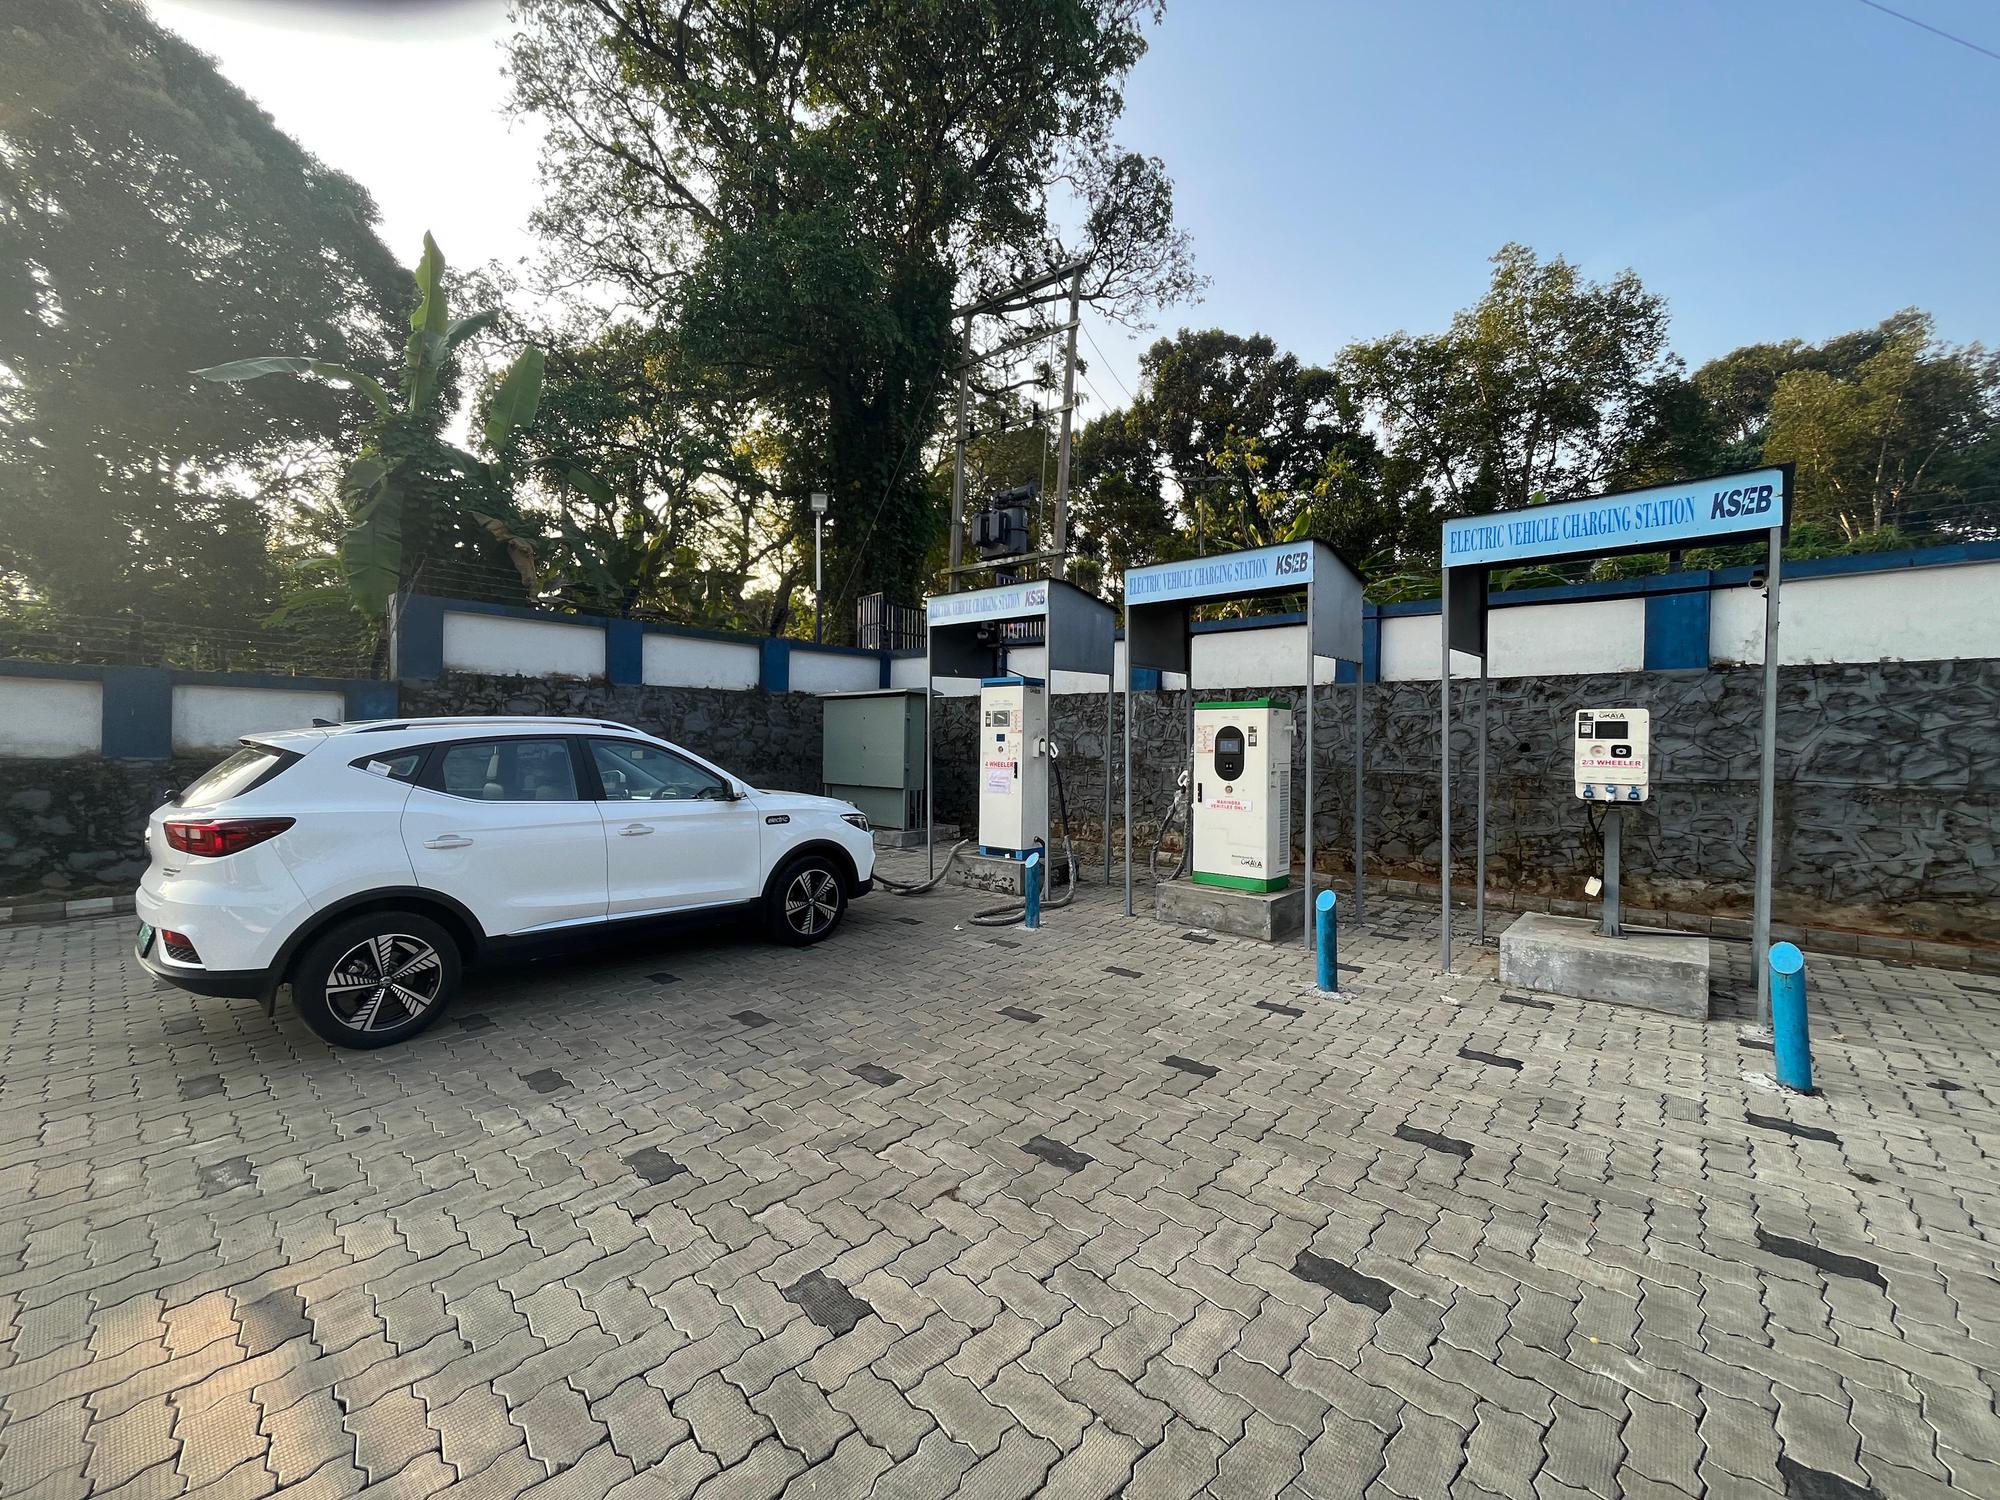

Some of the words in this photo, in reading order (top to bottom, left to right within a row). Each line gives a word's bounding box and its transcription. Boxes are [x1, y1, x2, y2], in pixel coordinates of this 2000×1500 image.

[1710, 484, 1773, 520] KSEB
[1450, 524, 1504, 553] ELECTRIC
[1507, 517, 1559, 546] VEHICLE
[1563, 506, 1631, 539] CHARGING
[1635, 496, 1696, 529] STATION
[1130, 573, 1161, 595] ELECTRIC
[1163, 569, 1192, 590] VEHICLE
[1195, 563, 1232, 586] CHARGING
[1235, 558, 1267, 581] STATION
[1275, 552, 1308, 575] KSEB
[1025, 589, 1045, 607] KSEB
